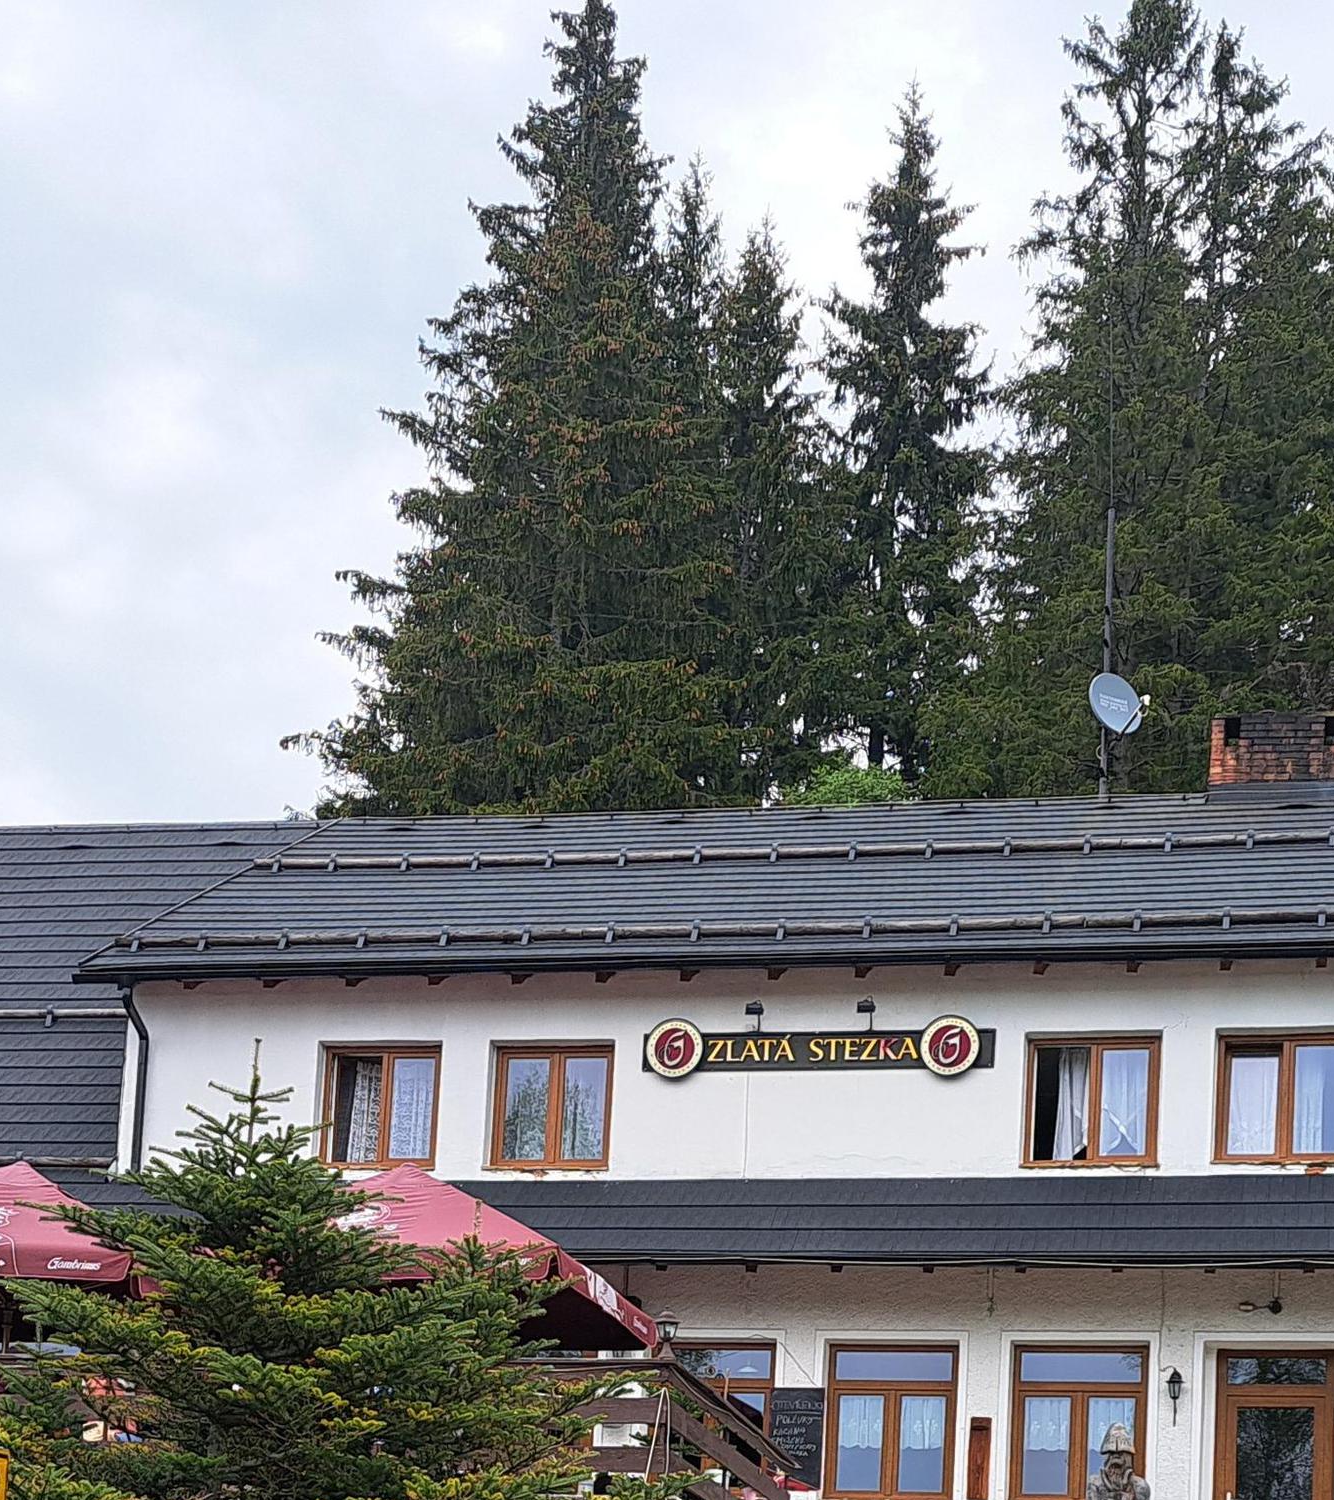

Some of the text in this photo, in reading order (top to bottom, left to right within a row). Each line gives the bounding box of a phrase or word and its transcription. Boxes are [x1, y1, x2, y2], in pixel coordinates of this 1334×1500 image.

[707, 1034, 795, 1062] ZLATÁ
[809, 1037, 918, 1061] STEZKA
[47, 1257, 102, 1271] Gambrinus
